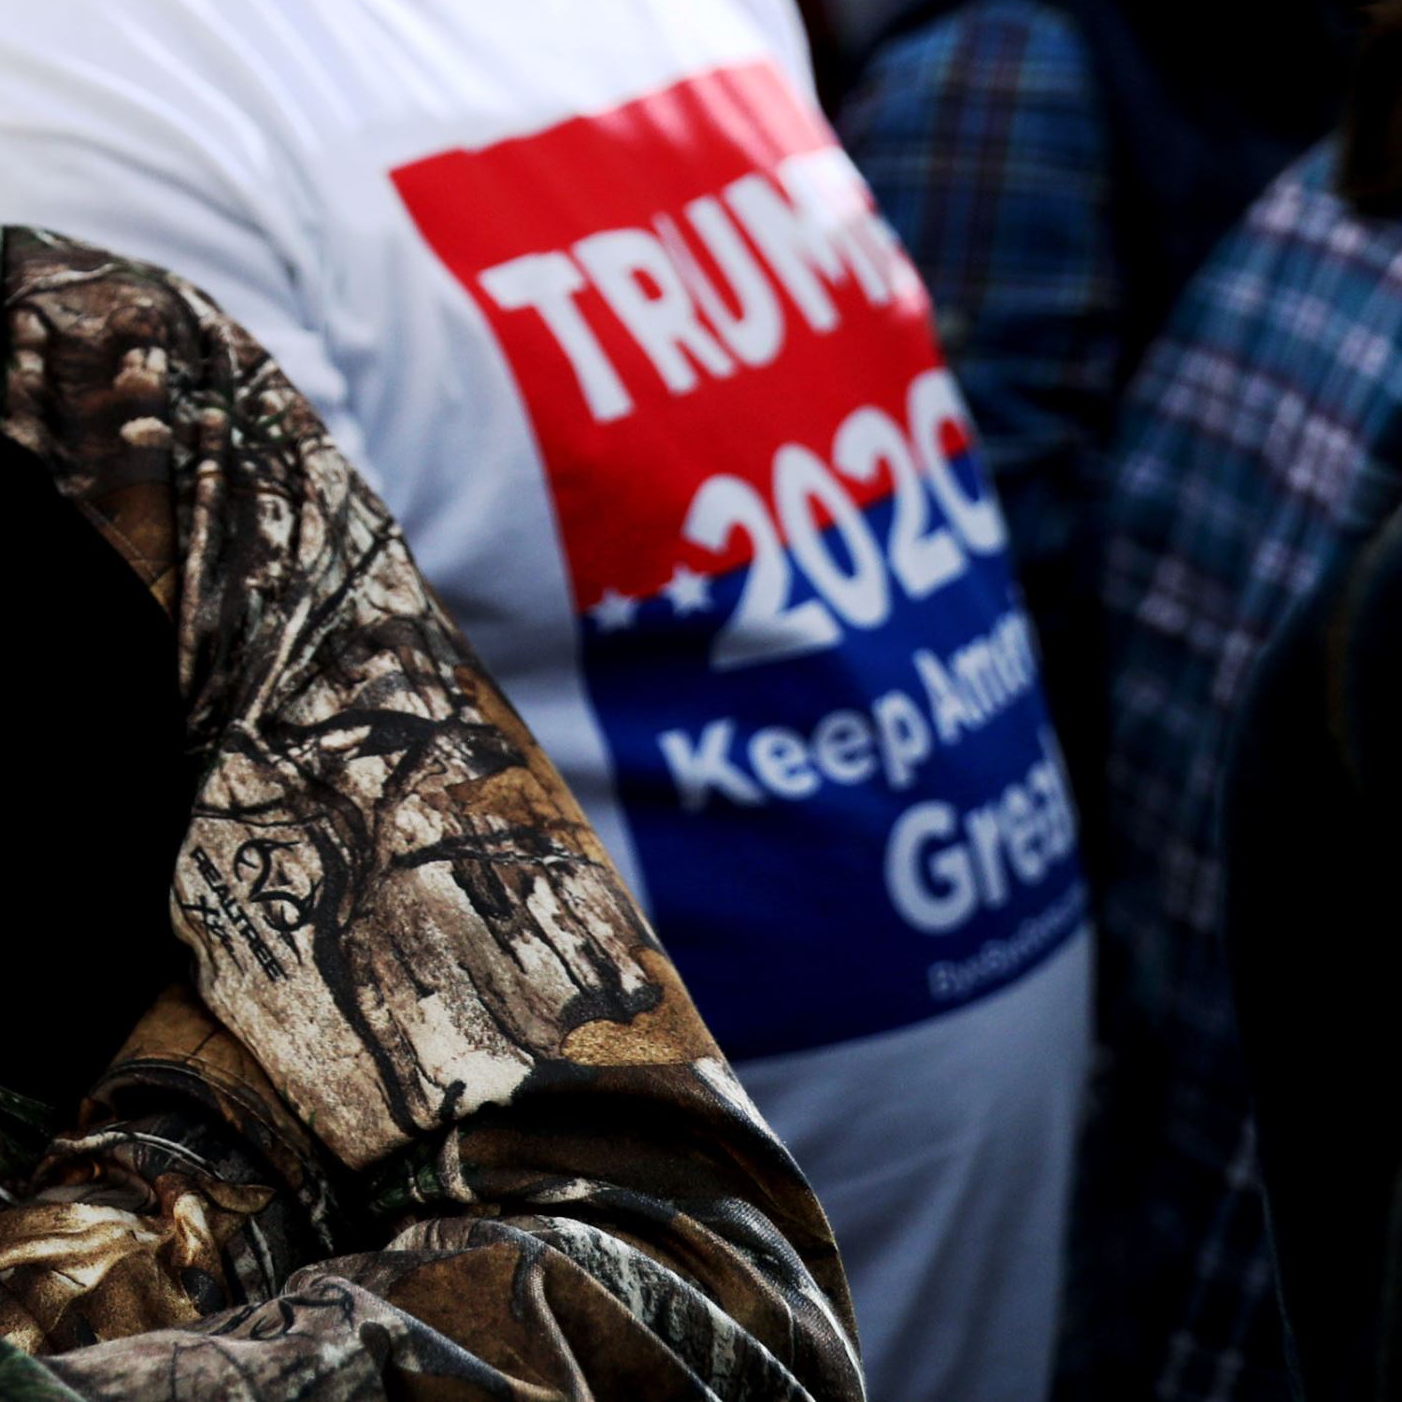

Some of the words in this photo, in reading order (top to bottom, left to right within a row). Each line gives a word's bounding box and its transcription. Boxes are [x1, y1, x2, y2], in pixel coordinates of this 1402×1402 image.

[477, 145, 924, 424] TRUM
[679, 366, 1010, 672] 2020
[657, 689, 933, 814] Keep
